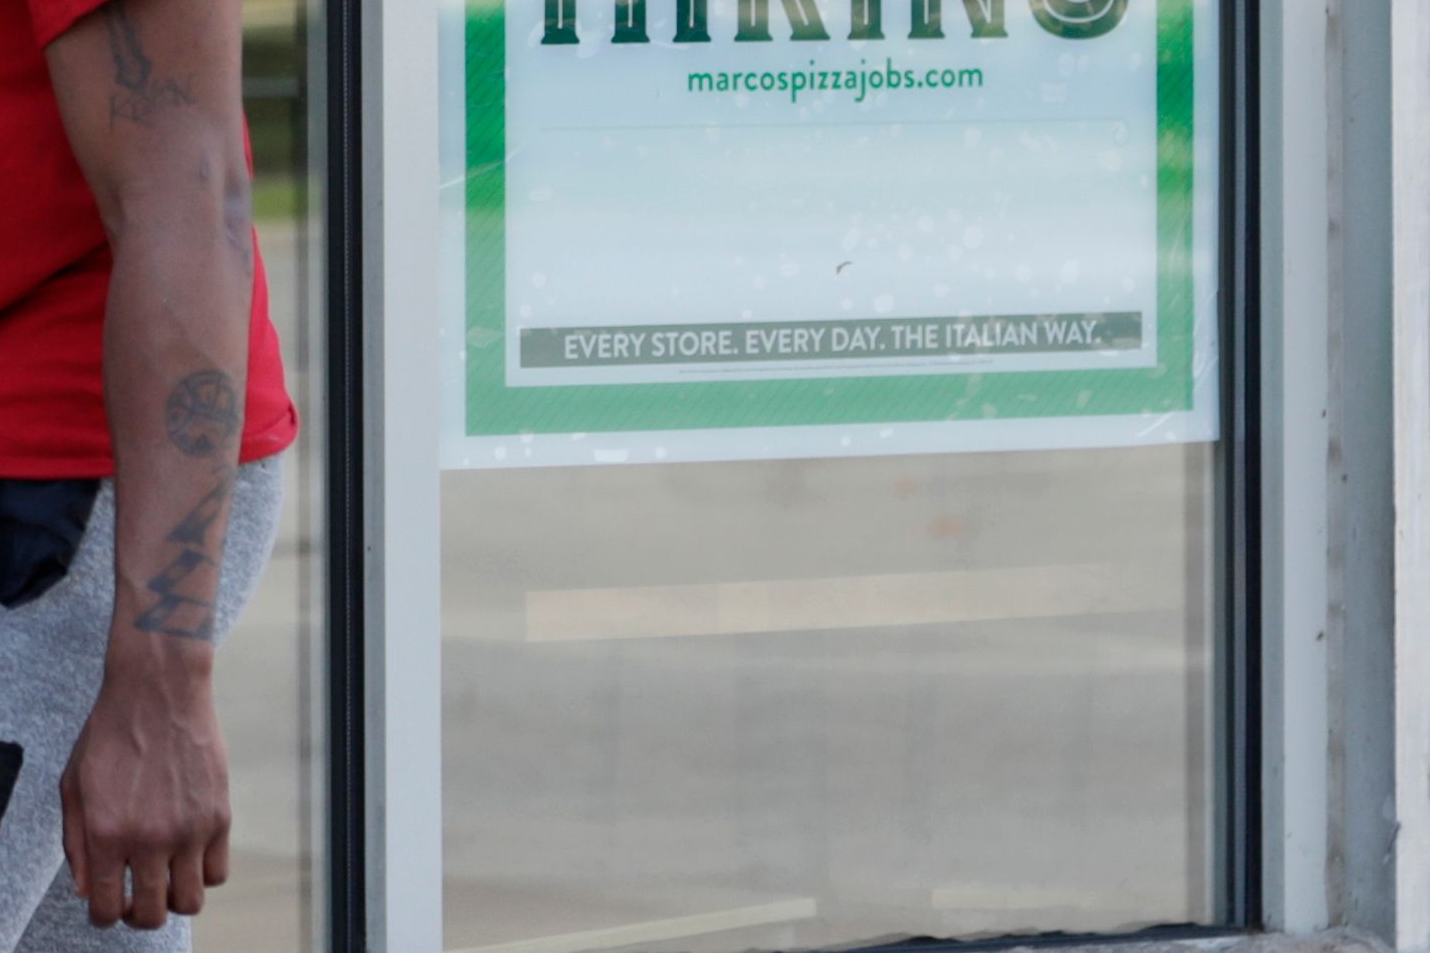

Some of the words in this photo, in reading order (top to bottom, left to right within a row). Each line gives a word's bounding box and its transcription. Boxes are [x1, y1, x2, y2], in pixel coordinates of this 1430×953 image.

[687, 57, 985, 102] marcospizzajobs.com
[563, 332, 646, 360] EVERY
[651, 330, 739, 358] STORE.
[744, 327, 826, 355] EVERY
[831, 325, 886, 353] DAY.
[891, 323, 940, 350] THE
[945, 321, 1039, 348] ITALIAN
[1043, 319, 1103, 346] WAY.
